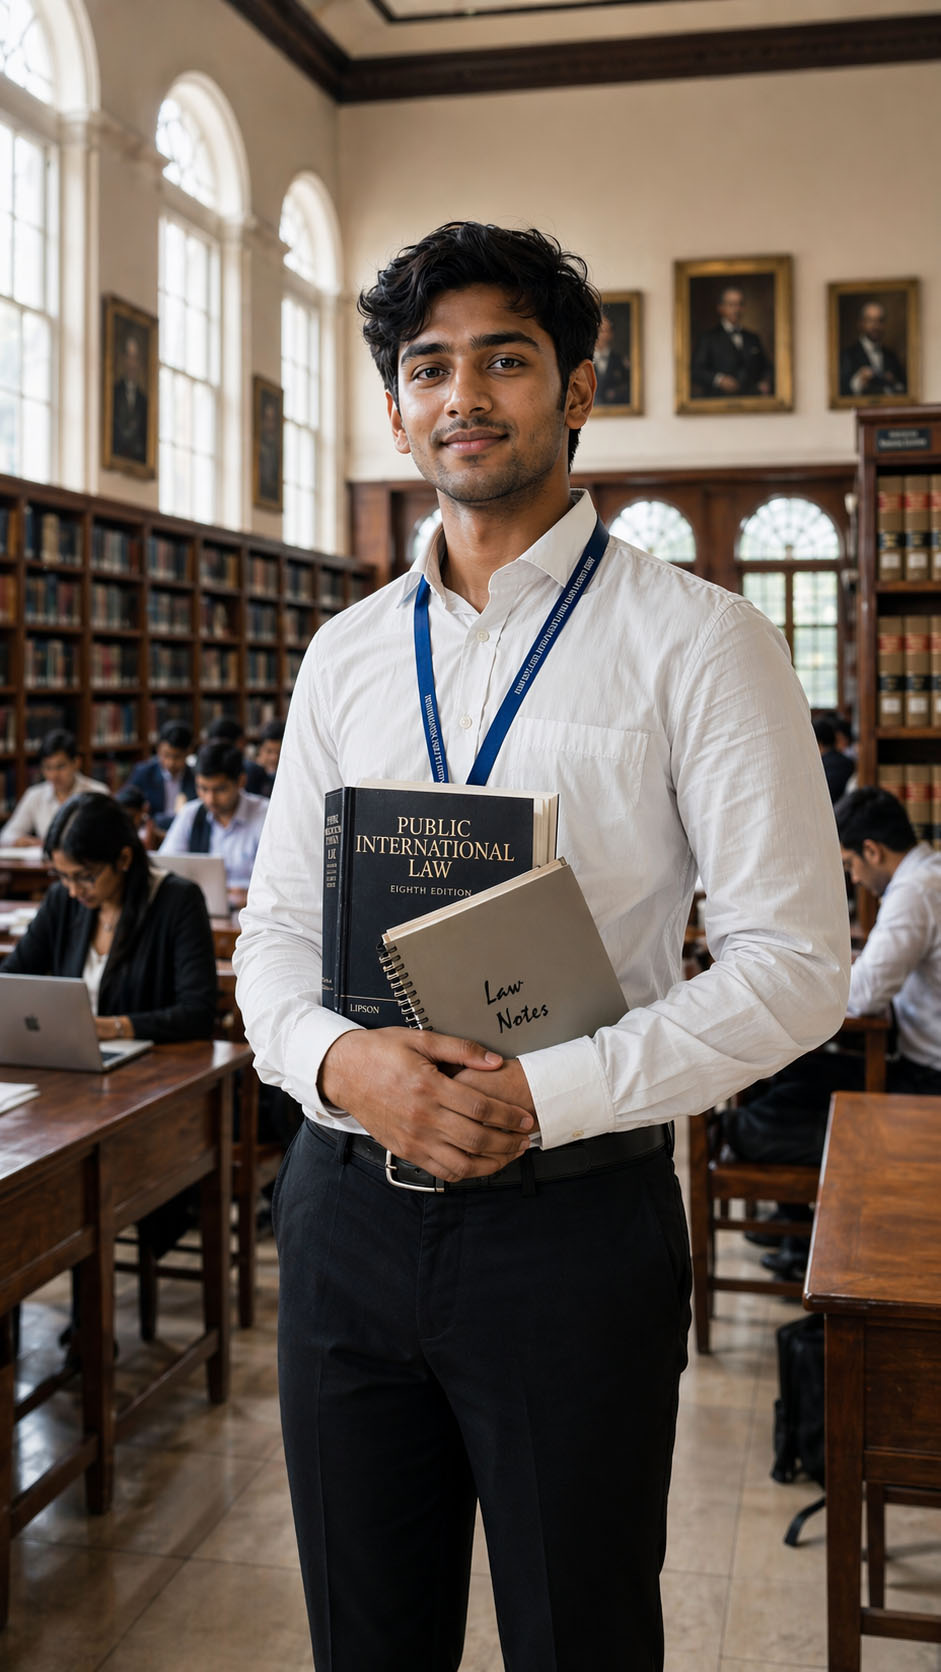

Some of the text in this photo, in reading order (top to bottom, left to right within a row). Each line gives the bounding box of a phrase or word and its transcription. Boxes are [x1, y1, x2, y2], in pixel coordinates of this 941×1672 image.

[397, 816, 471, 837] PUBLIC
[356, 835, 514, 862] INTERNATIONAL
[408, 859, 452, 879] LAW
[390, 884, 472, 897] EIGHTH EDITION
[484, 979, 524, 1005] Law
[350, 1003, 380, 1014] LIPSON
[496, 1003, 549, 1033] Notes
